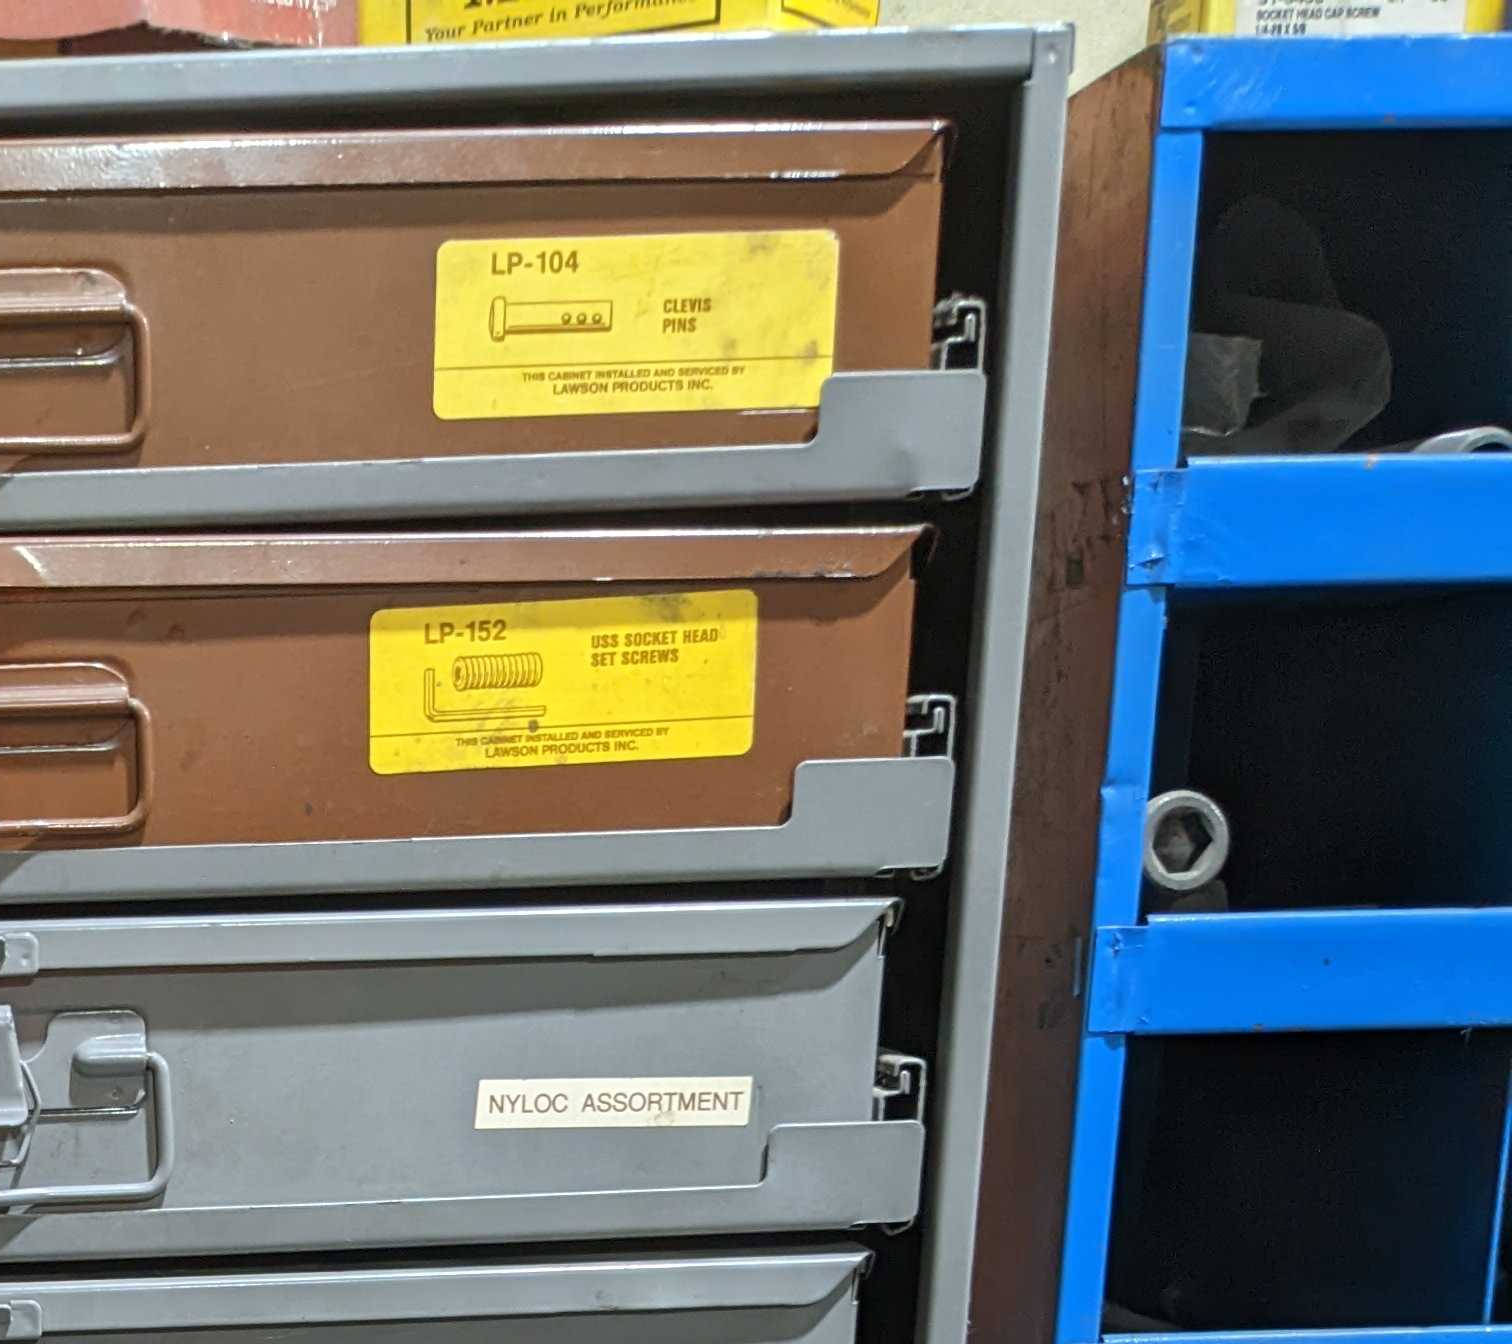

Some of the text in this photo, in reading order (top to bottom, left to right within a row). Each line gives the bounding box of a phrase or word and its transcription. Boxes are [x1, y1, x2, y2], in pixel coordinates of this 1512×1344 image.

[425, 8, 568, 42] Your Partner in
[491, 250, 579, 276] LP-104
[663, 298, 712, 314] CLEVIS
[662, 317, 697, 334] PINS
[522, 366, 745, 382] THIS CABINET INSTALLED AND SERVICED BY
[553, 378, 714, 396] LAWSON PRODUCTS INC.
[423, 619, 507, 645] LP-152
[591, 628, 719, 649] USS SOCKET HEAD
[590, 648, 679, 667] SET SCREWS
[488, 1091, 744, 1113] NYLOC ASSORTMENT
